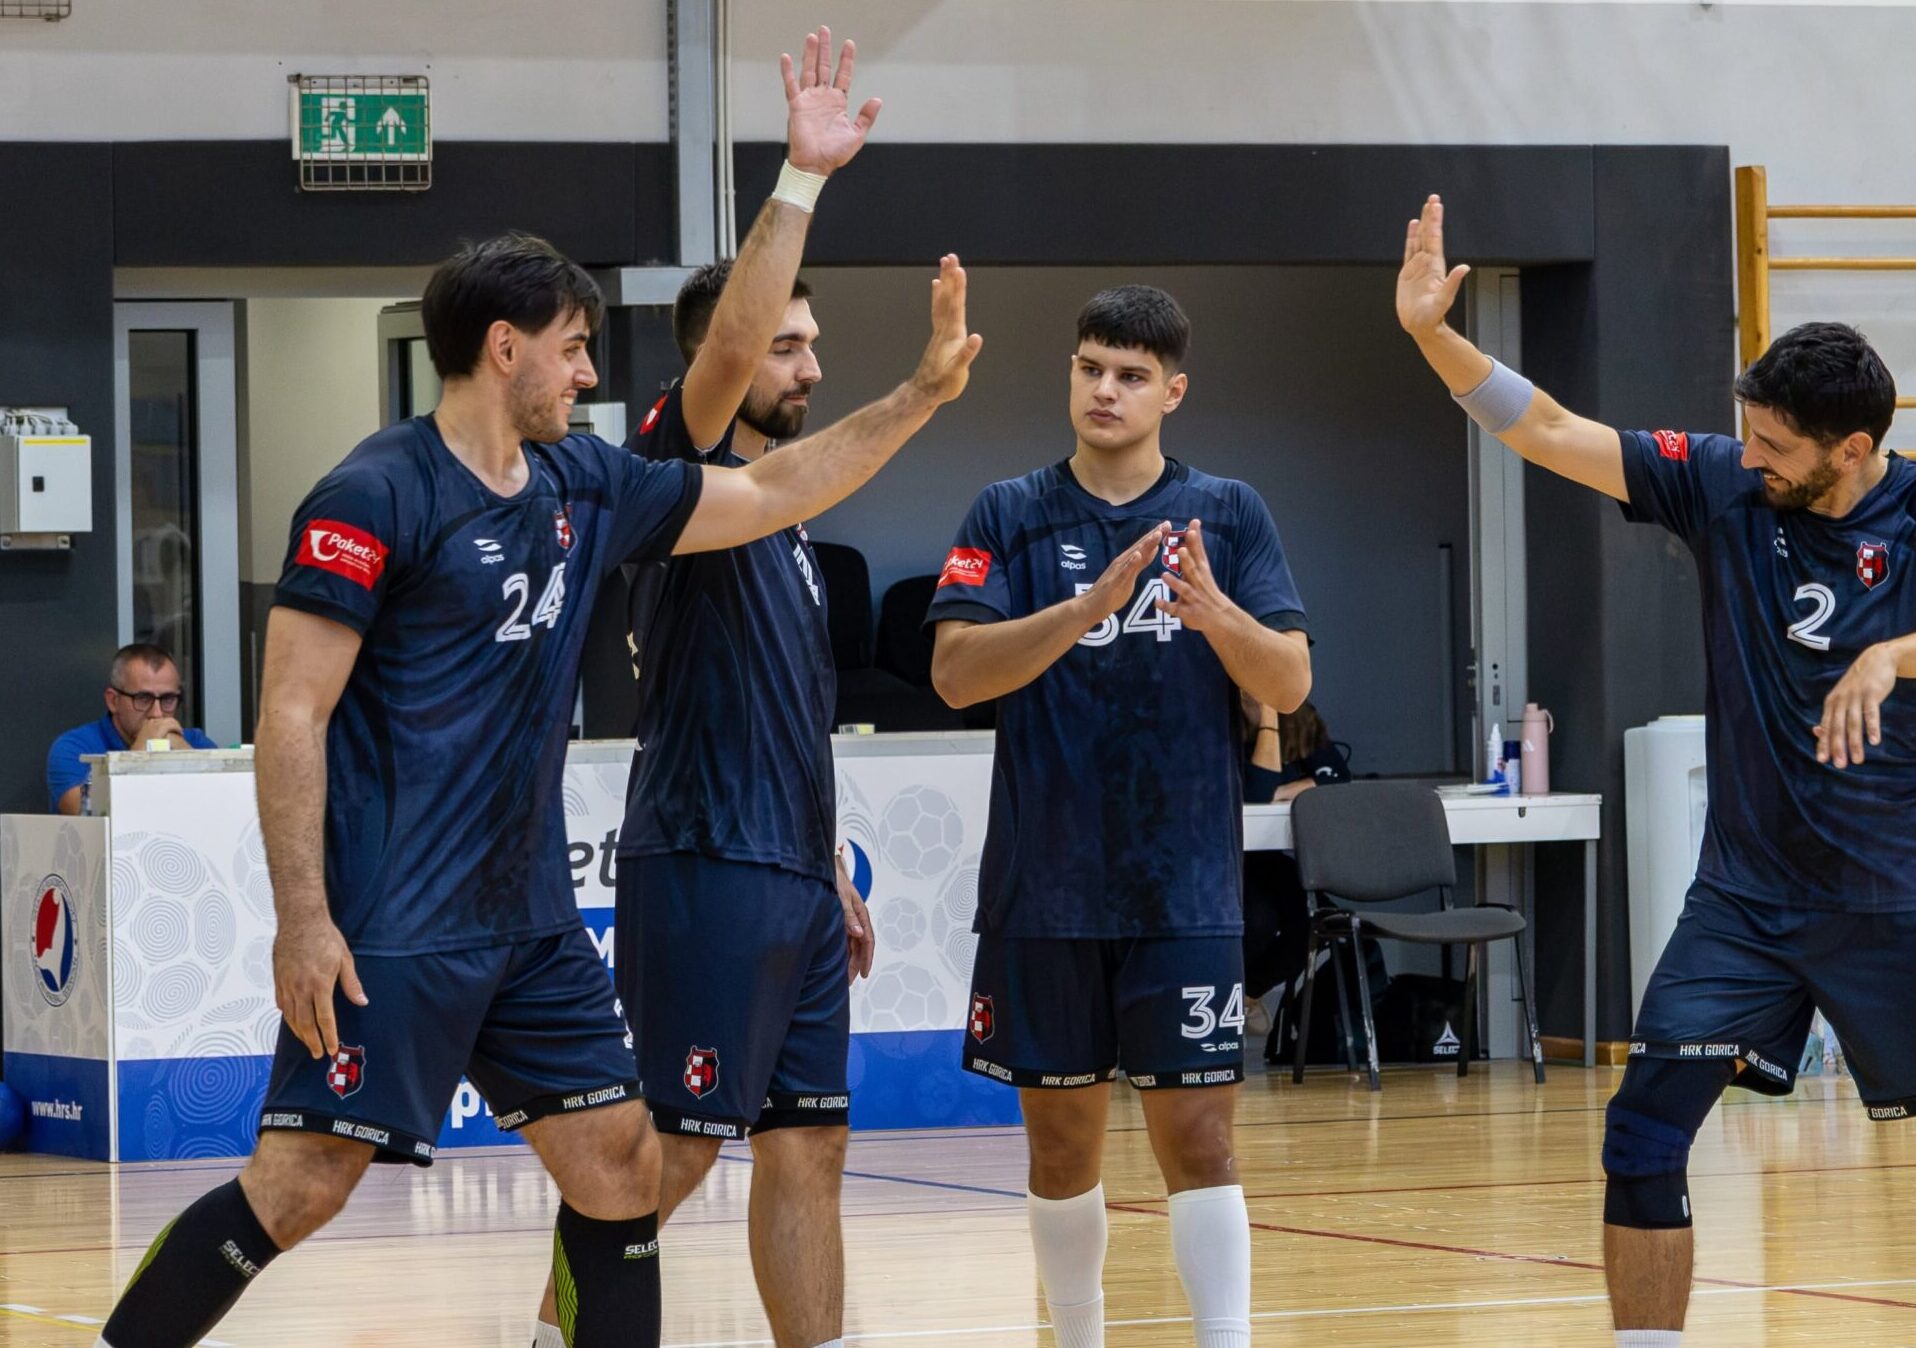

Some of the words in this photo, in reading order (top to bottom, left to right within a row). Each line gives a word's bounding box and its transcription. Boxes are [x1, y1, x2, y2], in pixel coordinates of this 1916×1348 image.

[1060, 560, 1087, 570] alpas
[495, 562, 568, 642] 24
[1787, 582, 1836, 651] 2
[1181, 983, 1245, 1039] 34
[1218, 1041, 1239, 1052] alpas
[1680, 1045, 1702, 1056] HRK
[1704, 1044, 1740, 1056] GORICA
[972, 1058, 988, 1072] HRK
[988, 1063, 1013, 1082] GORICA
[1181, 1072, 1202, 1084] HRK
[1203, 1069, 1236, 1083] GORICA
[1758, 1058, 1788, 1081] GORICA
[1041, 1075, 1062, 1085] HRK
[1062, 1073, 1096, 1086] GORICA
[563, 1097, 586, 1109] HRK
[587, 1085, 626, 1104] GORICA
[798, 1096, 818, 1108] HRK
[1870, 1106, 1908, 1119] GORICA
[332, 1119, 354, 1136] HRK
[353, 1125, 390, 1145] GORICA
[680, 1118, 701, 1134] HRK
[702, 1122, 737, 1137] GORICA
